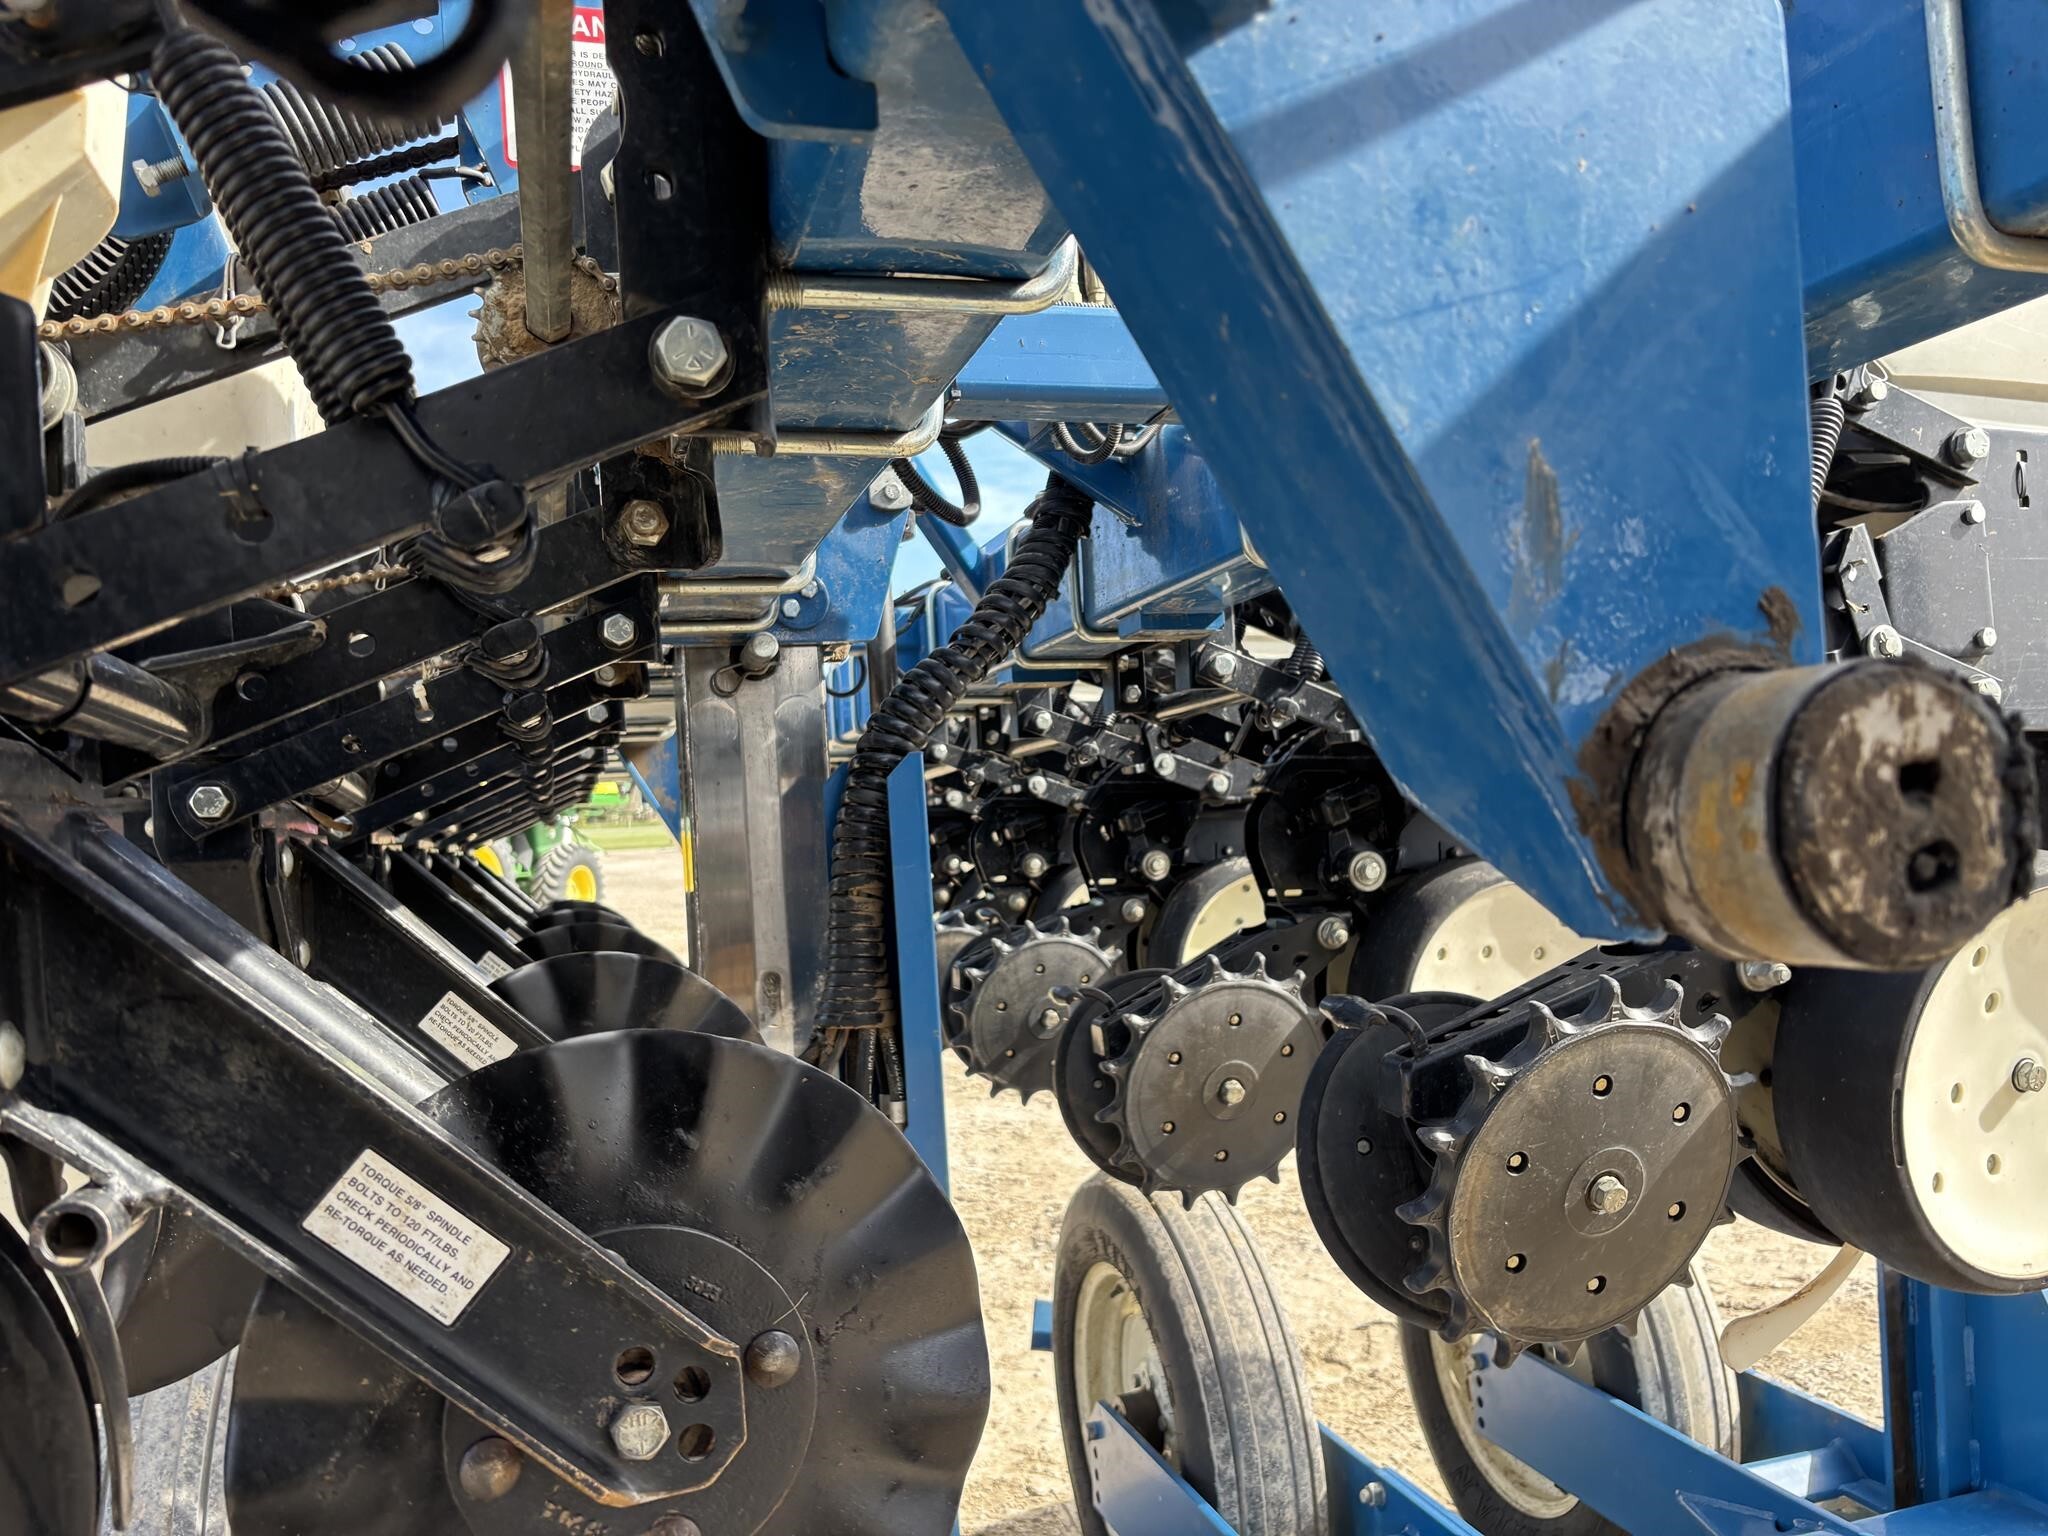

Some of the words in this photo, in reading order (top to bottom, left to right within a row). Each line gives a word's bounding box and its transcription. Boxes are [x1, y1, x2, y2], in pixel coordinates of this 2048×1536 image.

[580, 51, 588, 59] IS
[588, 80, 606, 89] MAY
[428, 1016, 459, 1043] RE-TORQUE
[457, 1040, 466, 1049] AS
[434, 1010, 454, 1028] CHECK
[453, 1025, 490, 1055] PERIODICALLY
[440, 1004, 458, 1020] BOLTS
[459, 1018, 466, 1026] TO
[446, 997, 468, 1017] TORQUE
[478, 1023, 500, 1043] SPINDLE
[347, 1176, 385, 1206] BOLTS
[387, 1202, 402, 1219] TO
[403, 1215, 421, 1233] 120
[421, 1227, 459, 1261] FT/LBS.
[360, 1162, 406, 1198] TORQUE
[404, 1196, 427, 1211] 5/8"
[426, 1210, 472, 1246] SPINDLE
[324, 1204, 388, 1252] RE-TORQUE
[386, 1249, 405, 1264] AS
[404, 1259, 449, 1296] NEEDED.
[336, 1191, 374, 1221] CHECK
[375, 1218, 451, 1274] PERIODICALLY
[450, 1271, 475, 1291] AND
